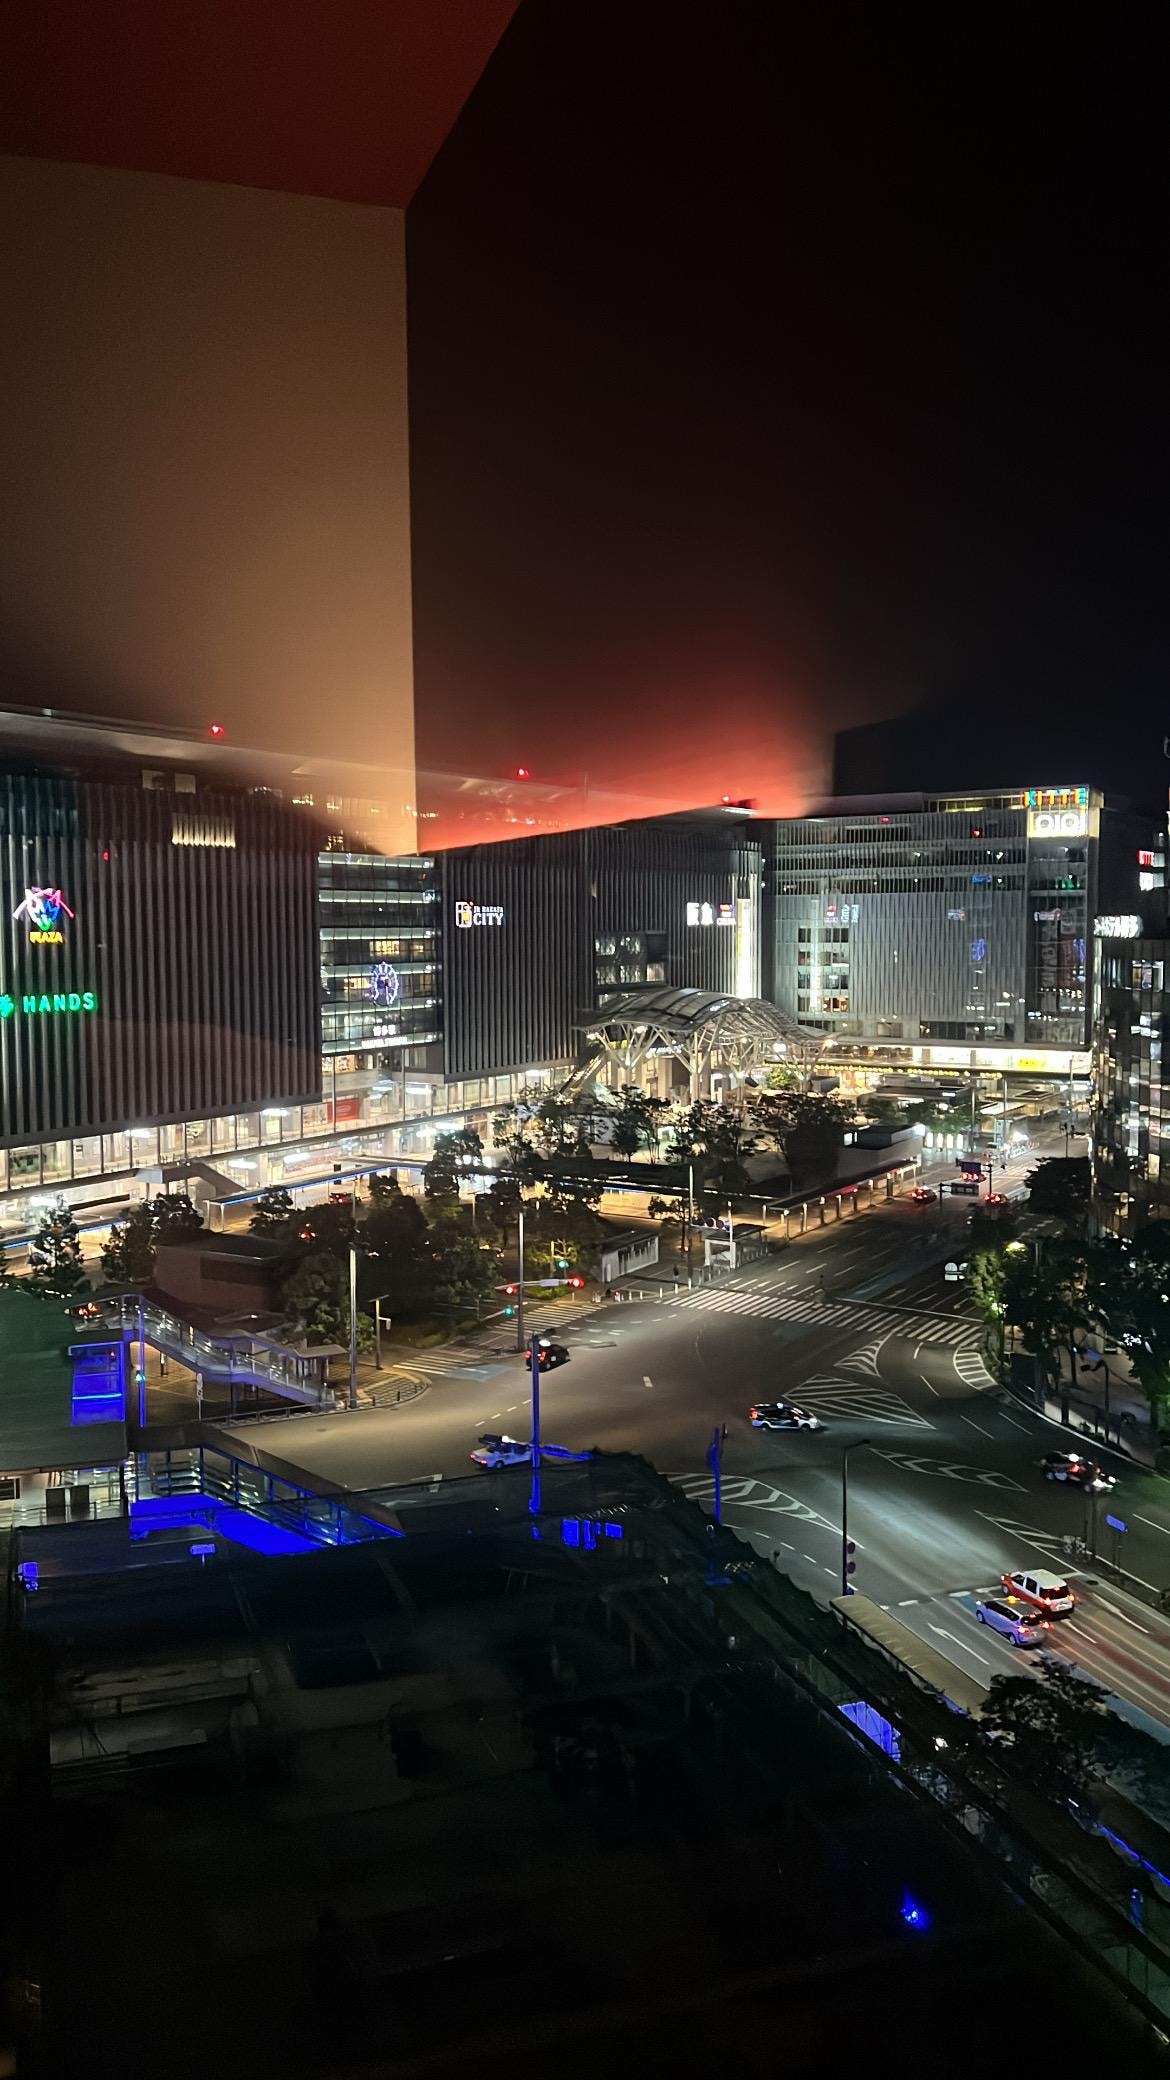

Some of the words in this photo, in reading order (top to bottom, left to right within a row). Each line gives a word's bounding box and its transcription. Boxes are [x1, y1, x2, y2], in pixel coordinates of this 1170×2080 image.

[1024, 788, 1086, 806] KITTE
[473, 912, 504, 926] CITY
[29, 931, 63, 944] PLAZA
[23, 991, 95, 1013] HANDS
